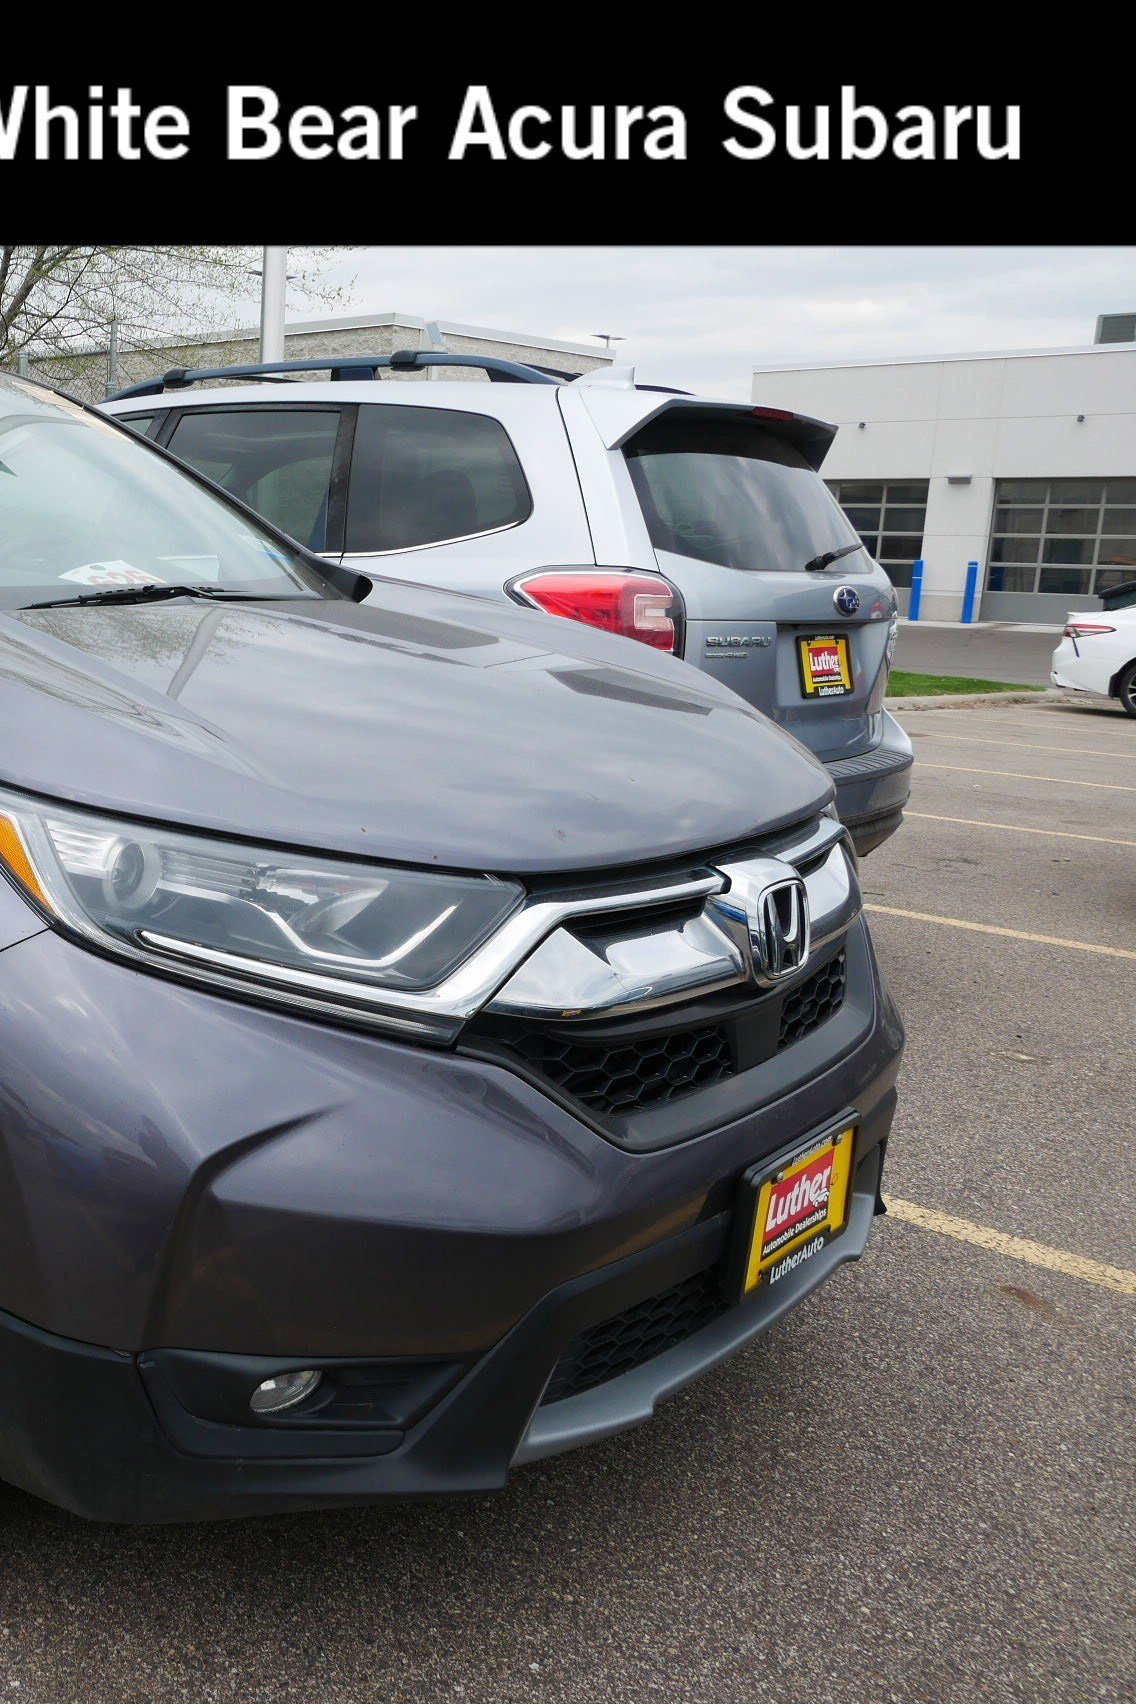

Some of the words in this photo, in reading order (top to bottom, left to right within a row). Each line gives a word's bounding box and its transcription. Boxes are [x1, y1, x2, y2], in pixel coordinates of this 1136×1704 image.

[706, 636, 771, 647] SUBARU
[809, 651, 840, 672] Luther
[766, 1166, 832, 1232] Luther
[762, 1228, 795, 1256] Automobile
[795, 1208, 827, 1233] Dealerships
[770, 1236, 824, 1285] LutherAuto
